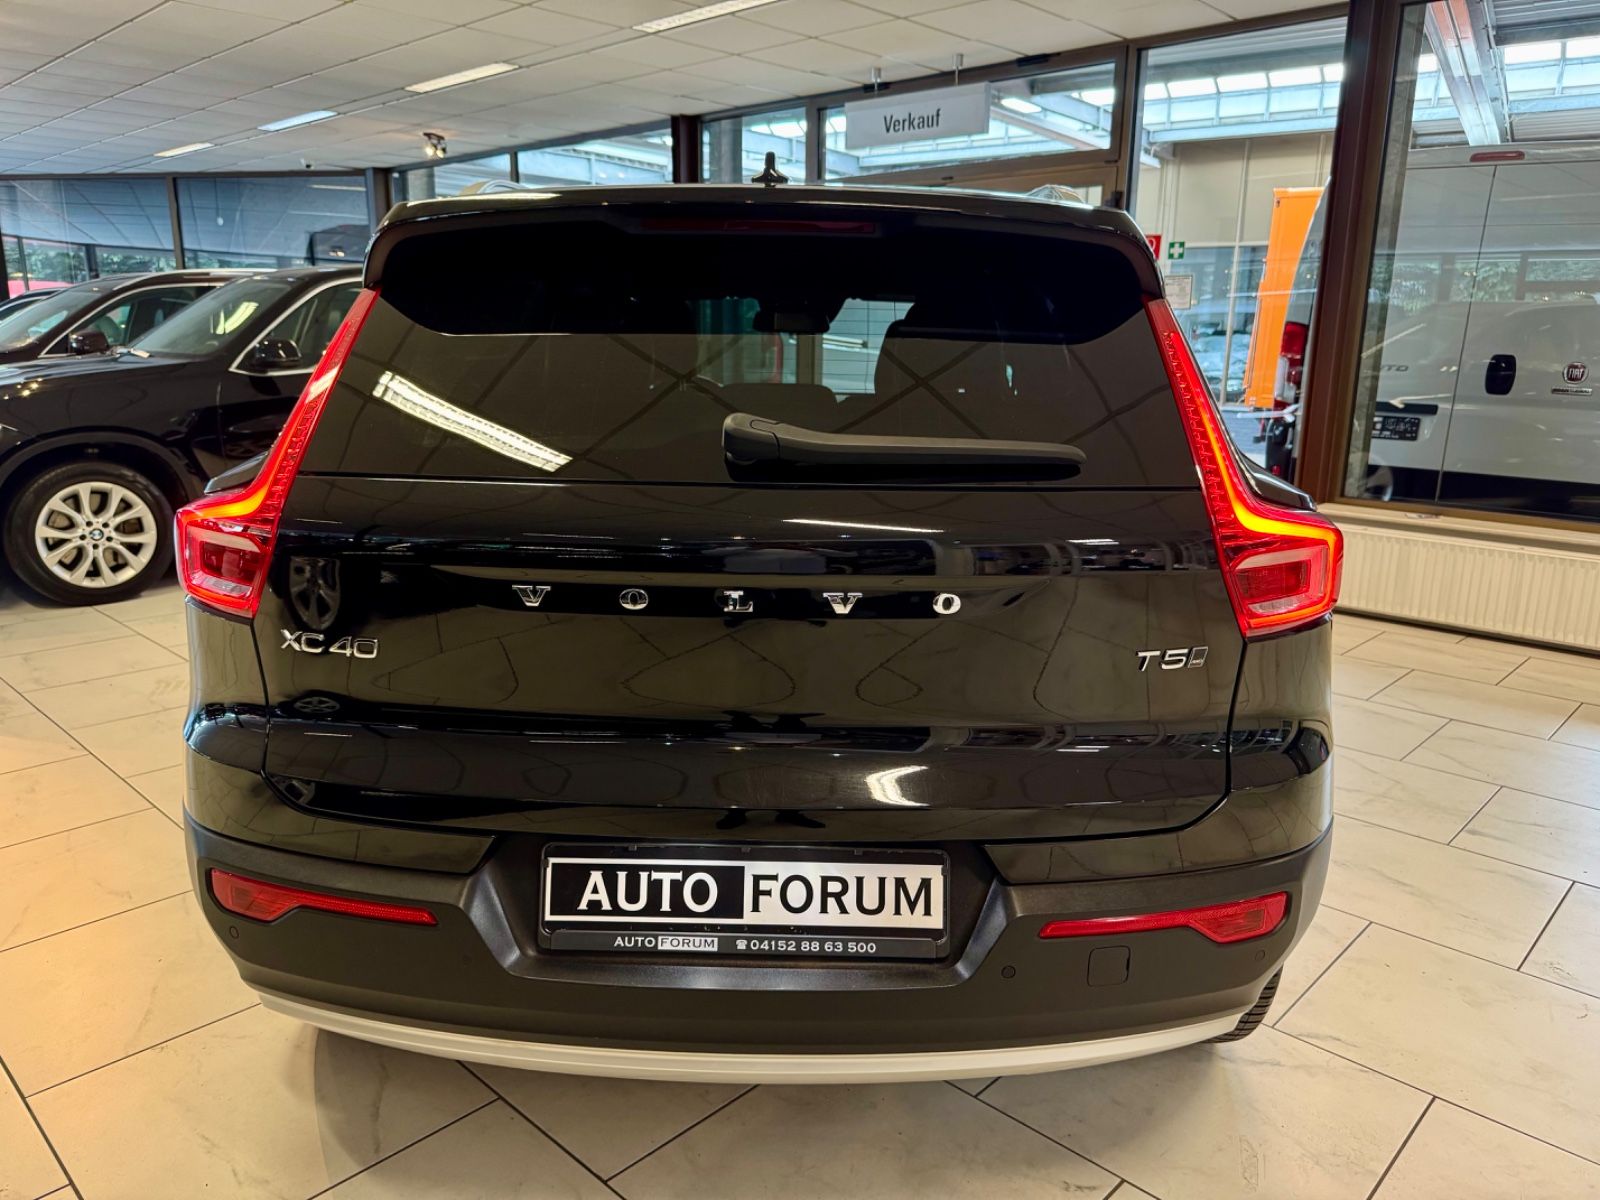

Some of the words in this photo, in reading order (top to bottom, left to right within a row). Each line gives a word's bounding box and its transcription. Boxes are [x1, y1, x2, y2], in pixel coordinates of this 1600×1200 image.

[883, 108, 941, 134] Verkauf
[1137, 648, 1189, 672] T5
[576, 869, 718, 913] AUTO
[749, 872, 933, 917] FORUM
[613, 936, 656, 948] AUTO
[660, 938, 716, 949] FORUM
[750, 939, 796, 951] 04152
[800, 940, 820, 952] 88
[824, 941, 843, 952] 63
[847, 942, 877, 953] 500
